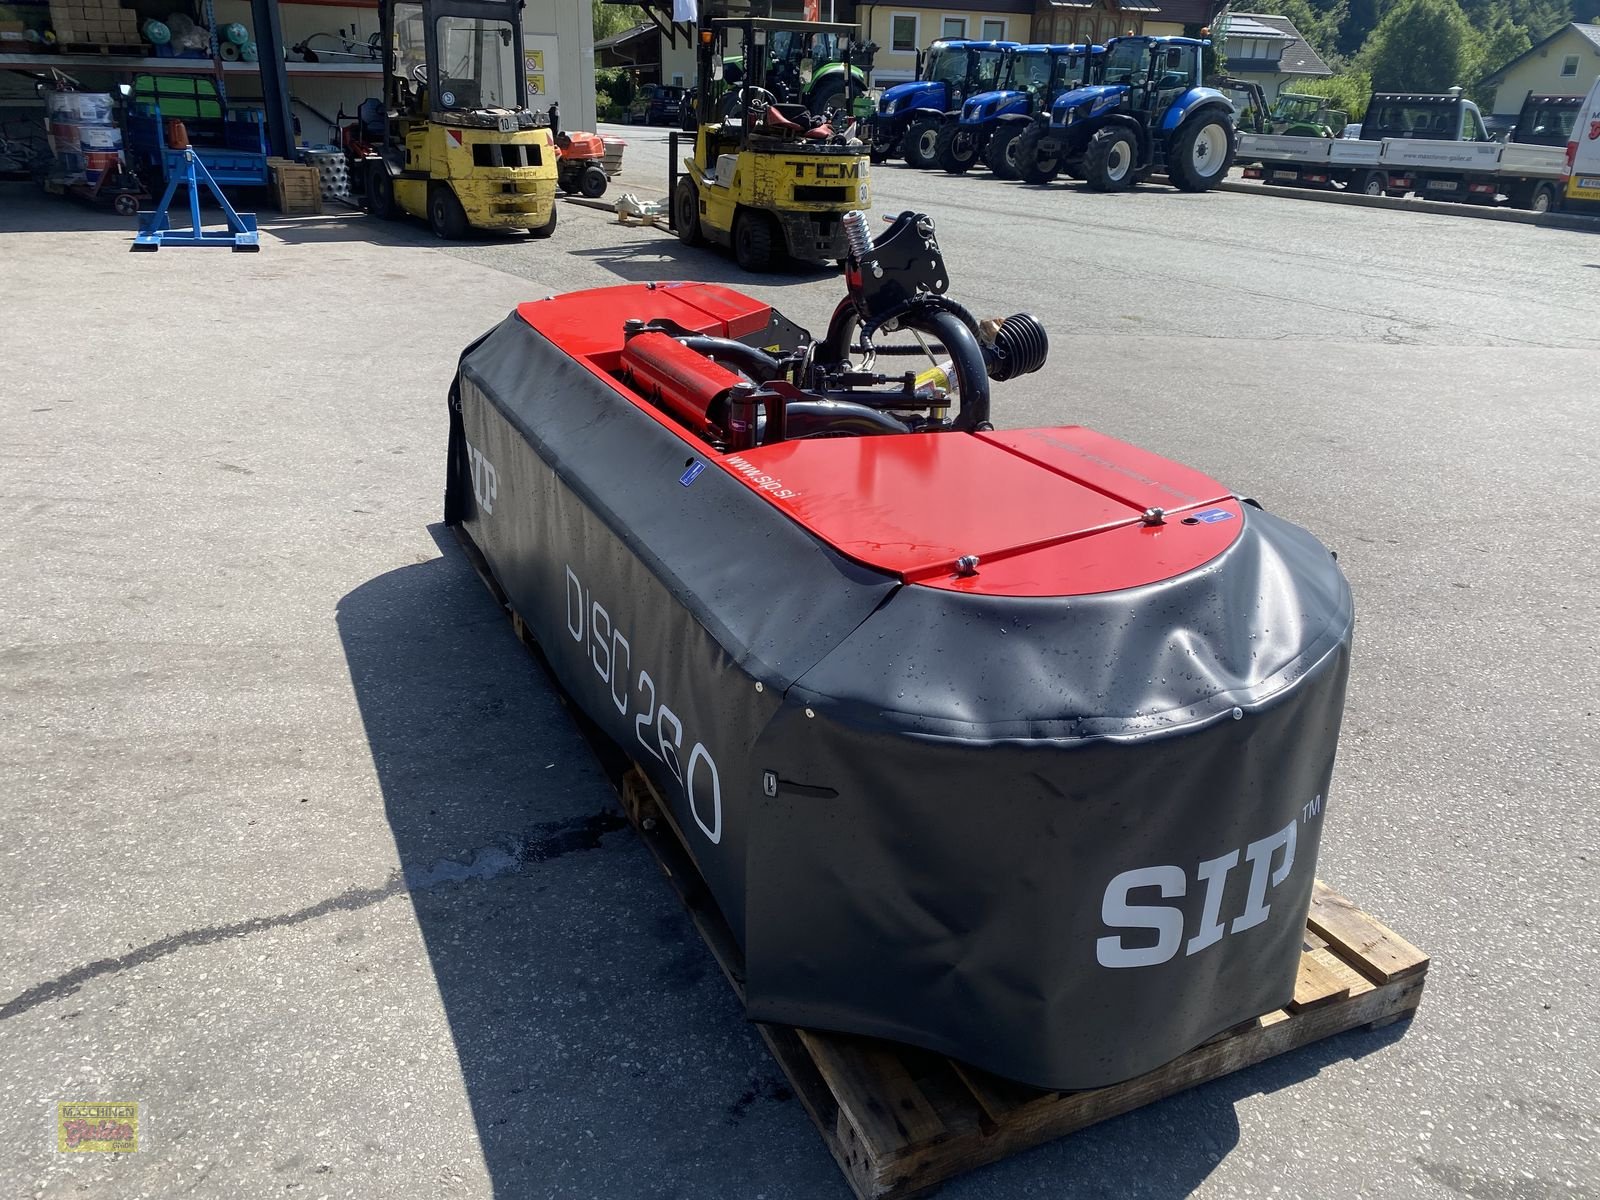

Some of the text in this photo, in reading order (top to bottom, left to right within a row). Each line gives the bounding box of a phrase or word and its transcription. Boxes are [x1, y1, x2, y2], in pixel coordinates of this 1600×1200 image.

[785, 161, 859, 179] TCM
[726, 455, 802, 499] www.sip.si
[565, 563, 722, 845] DISC 260
[1096, 819, 1298, 968] SIP
